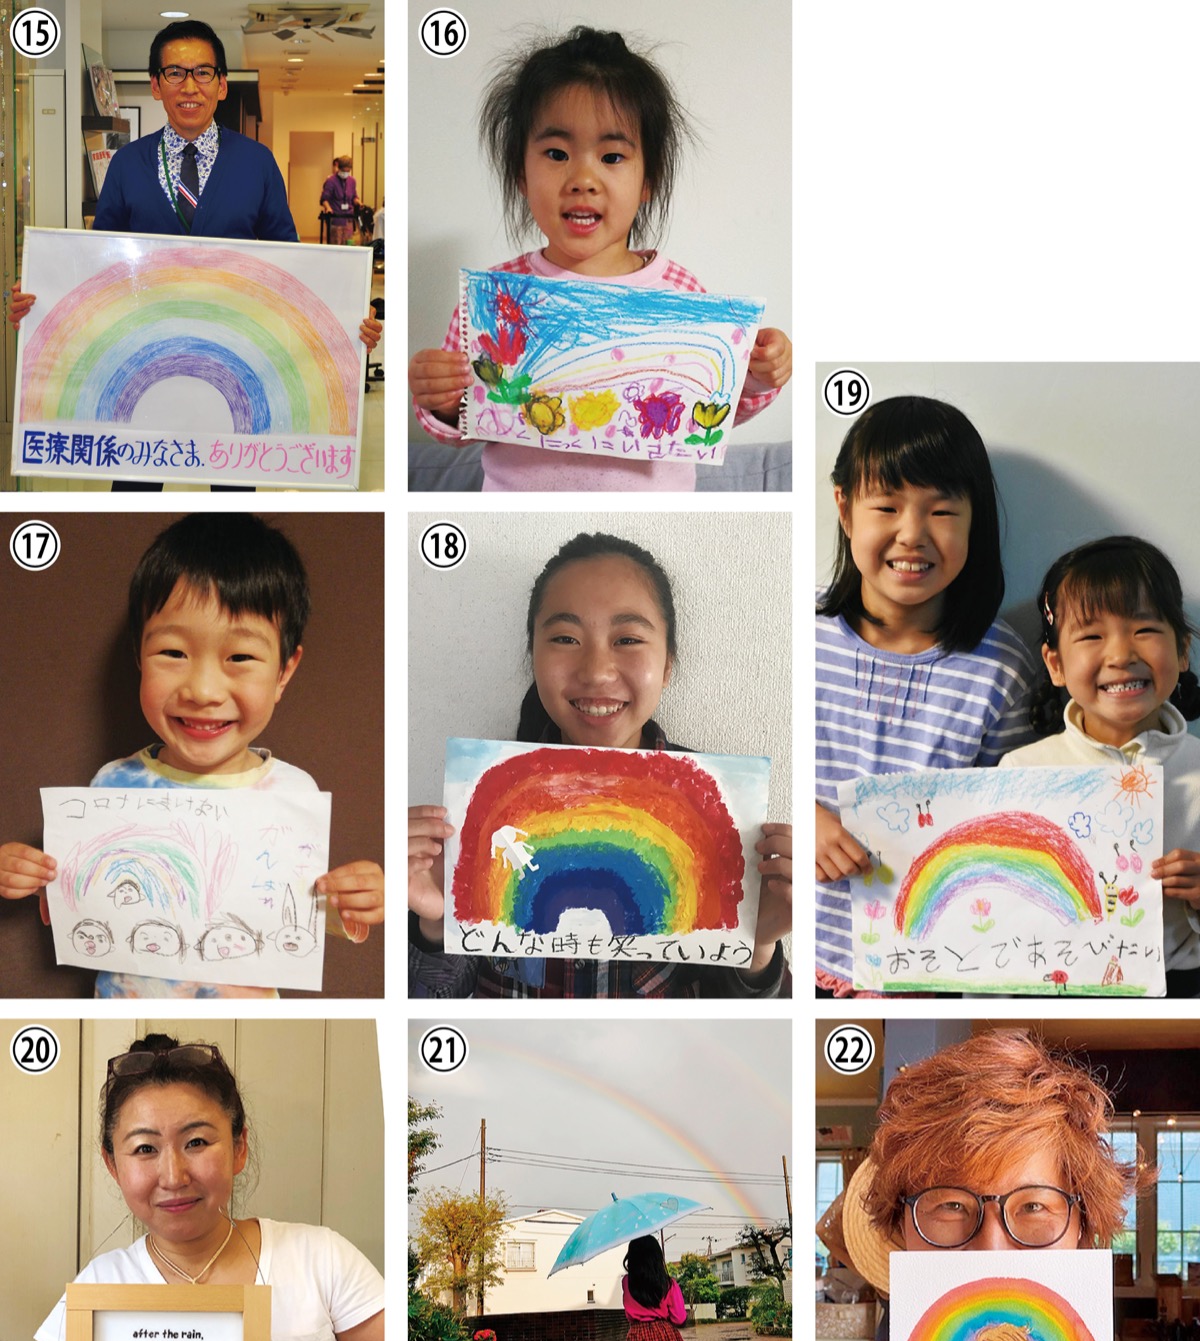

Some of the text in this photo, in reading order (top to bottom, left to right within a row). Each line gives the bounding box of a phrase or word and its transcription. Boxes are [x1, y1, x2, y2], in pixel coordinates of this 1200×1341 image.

[459, 925, 752, 965] どんな時も笑っていよう
[886, 934, 1161, 974] おそとであそびたい
[132, 1329, 204, 1340] after the rain,
